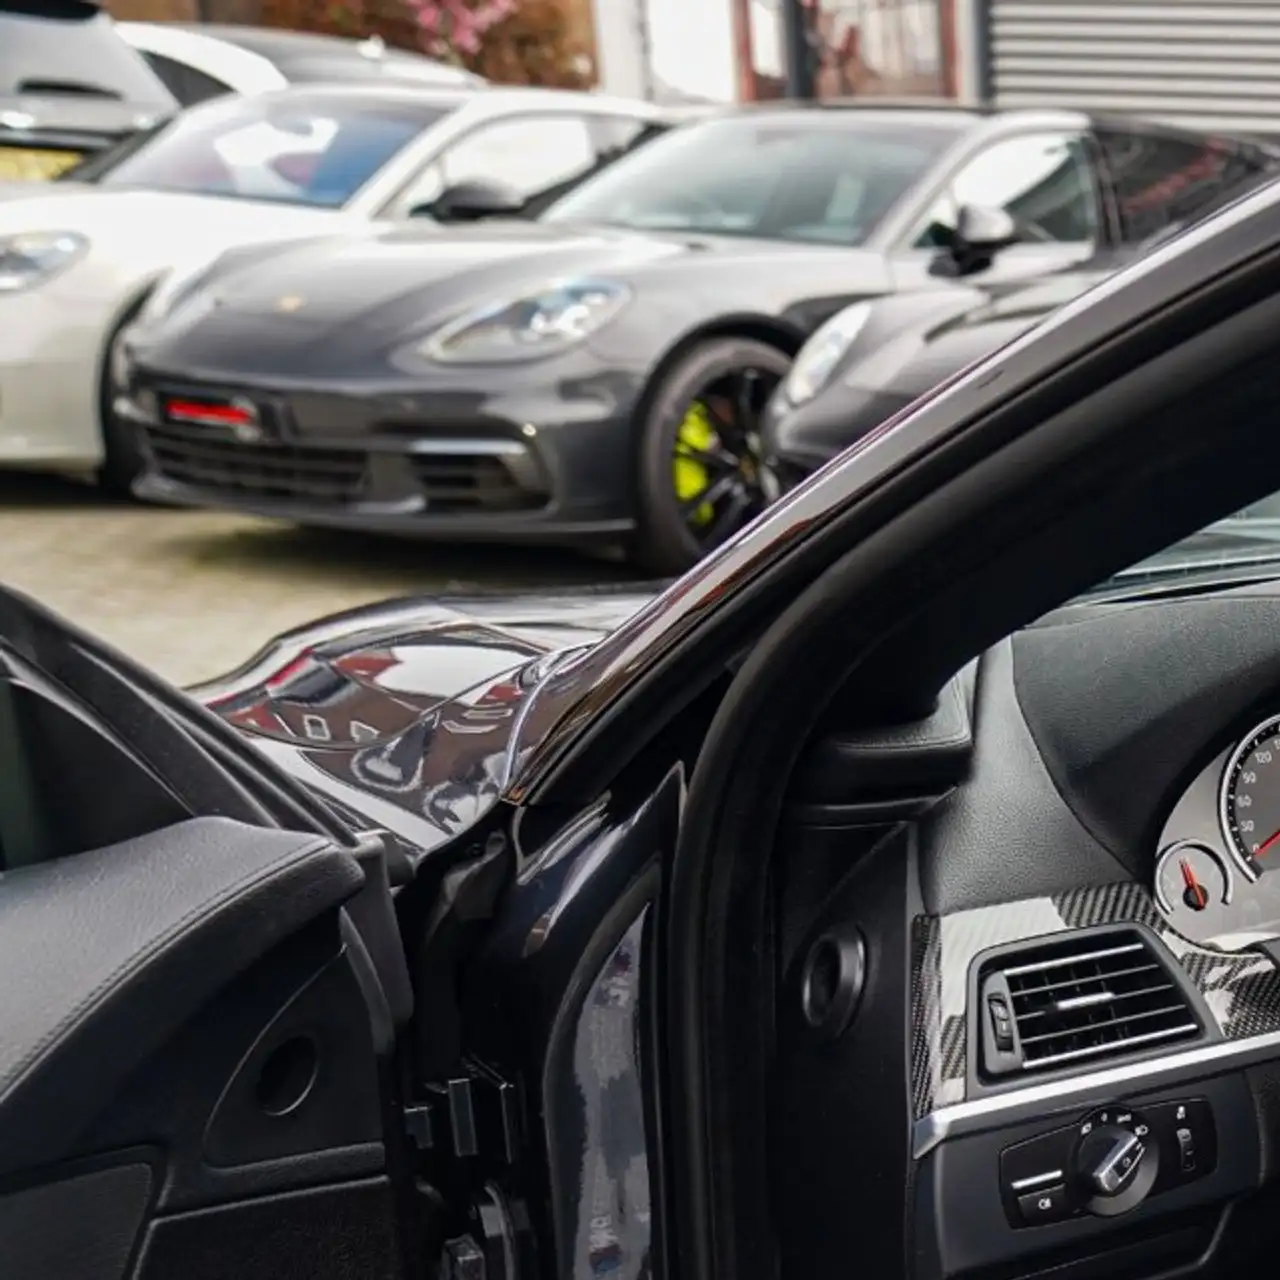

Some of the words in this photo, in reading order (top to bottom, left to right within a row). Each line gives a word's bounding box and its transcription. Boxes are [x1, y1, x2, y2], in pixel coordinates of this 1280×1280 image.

[1255, 751, 1272, 763] 120
[1242, 772, 1256, 783] 90
[1237, 796, 1252, 807] 60
[1241, 820, 1254, 831] 30
